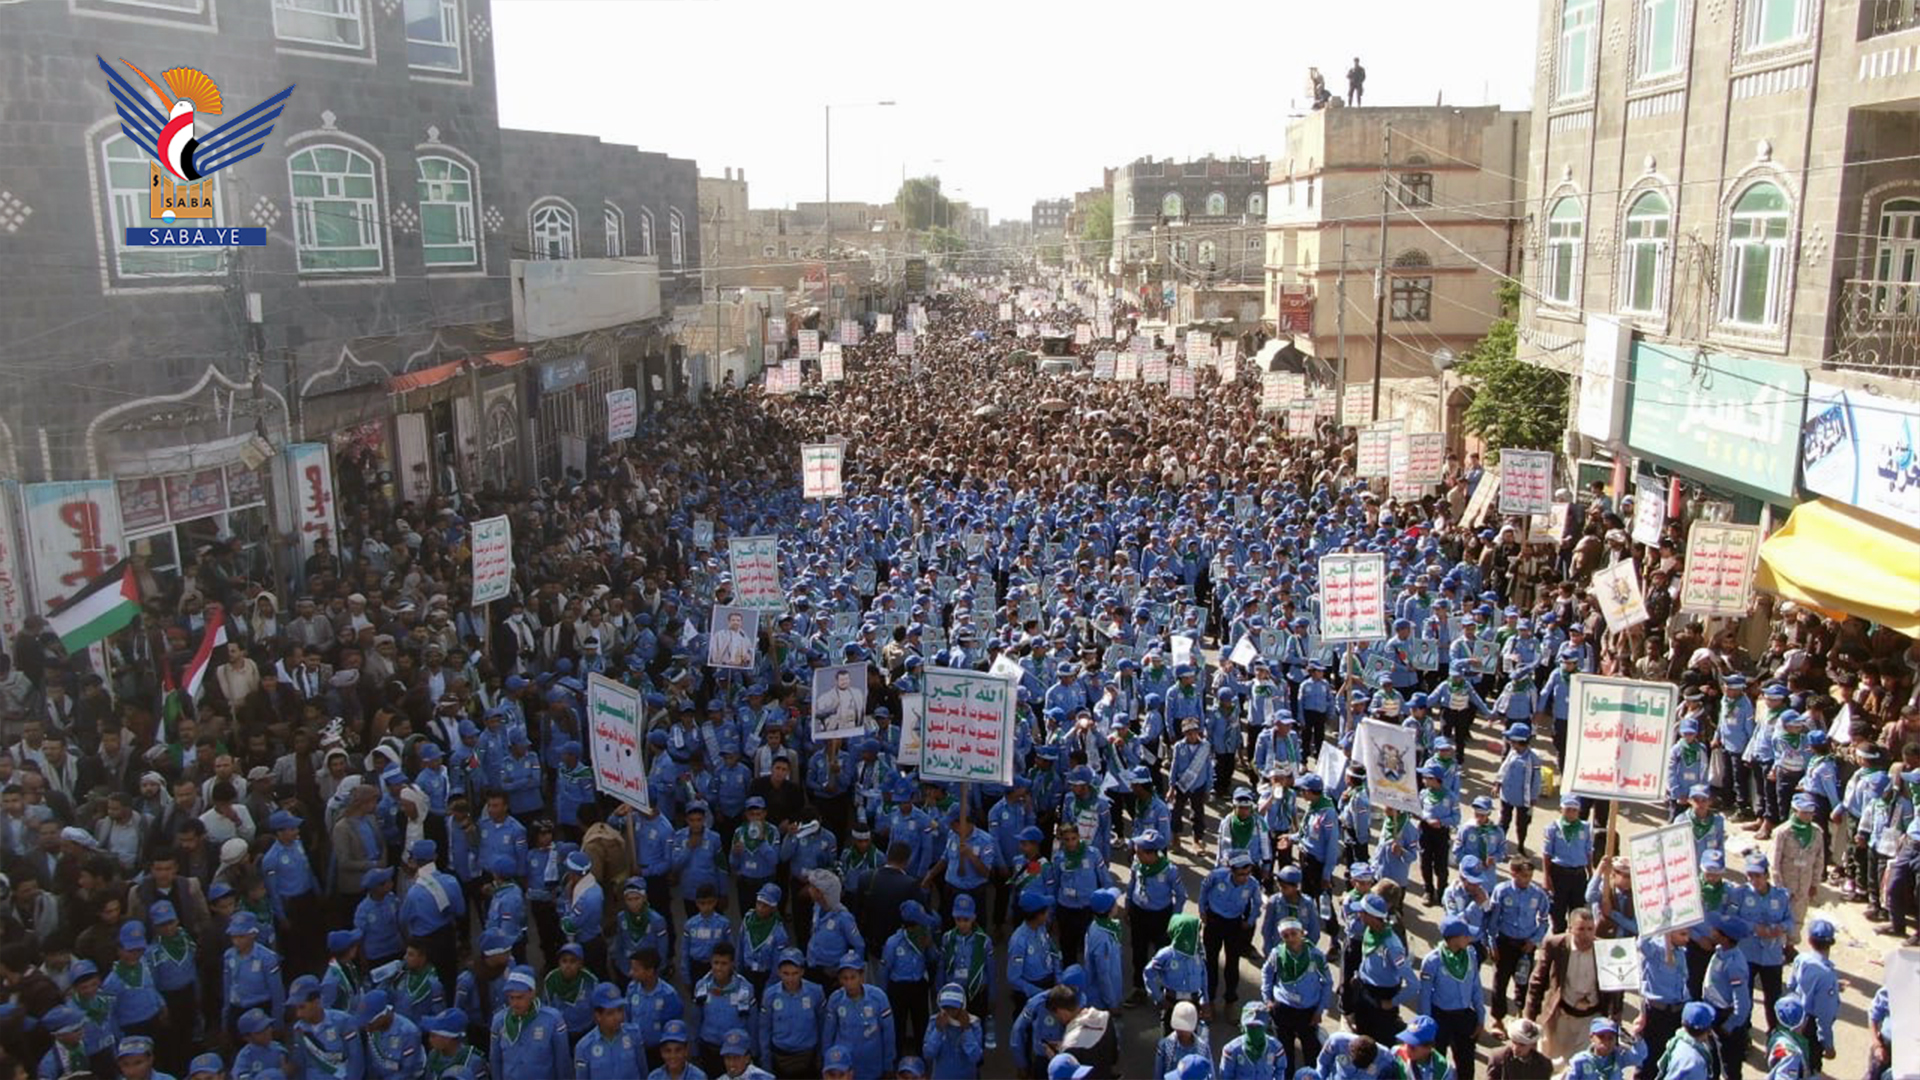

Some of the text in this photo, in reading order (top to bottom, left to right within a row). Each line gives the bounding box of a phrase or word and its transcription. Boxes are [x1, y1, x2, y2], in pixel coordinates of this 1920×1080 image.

[1358, 562, 1377, 572] الله
[975, 684, 1003, 702] الله
[1586, 691, 1666, 717] قاطعوا
[969, 710, 1001, 722] الموت
[968, 728, 1001, 740] الموت
[926, 737, 1000, 757] اللعنة على اليهود
[926, 754, 1000, 775] النصر للإسلام
